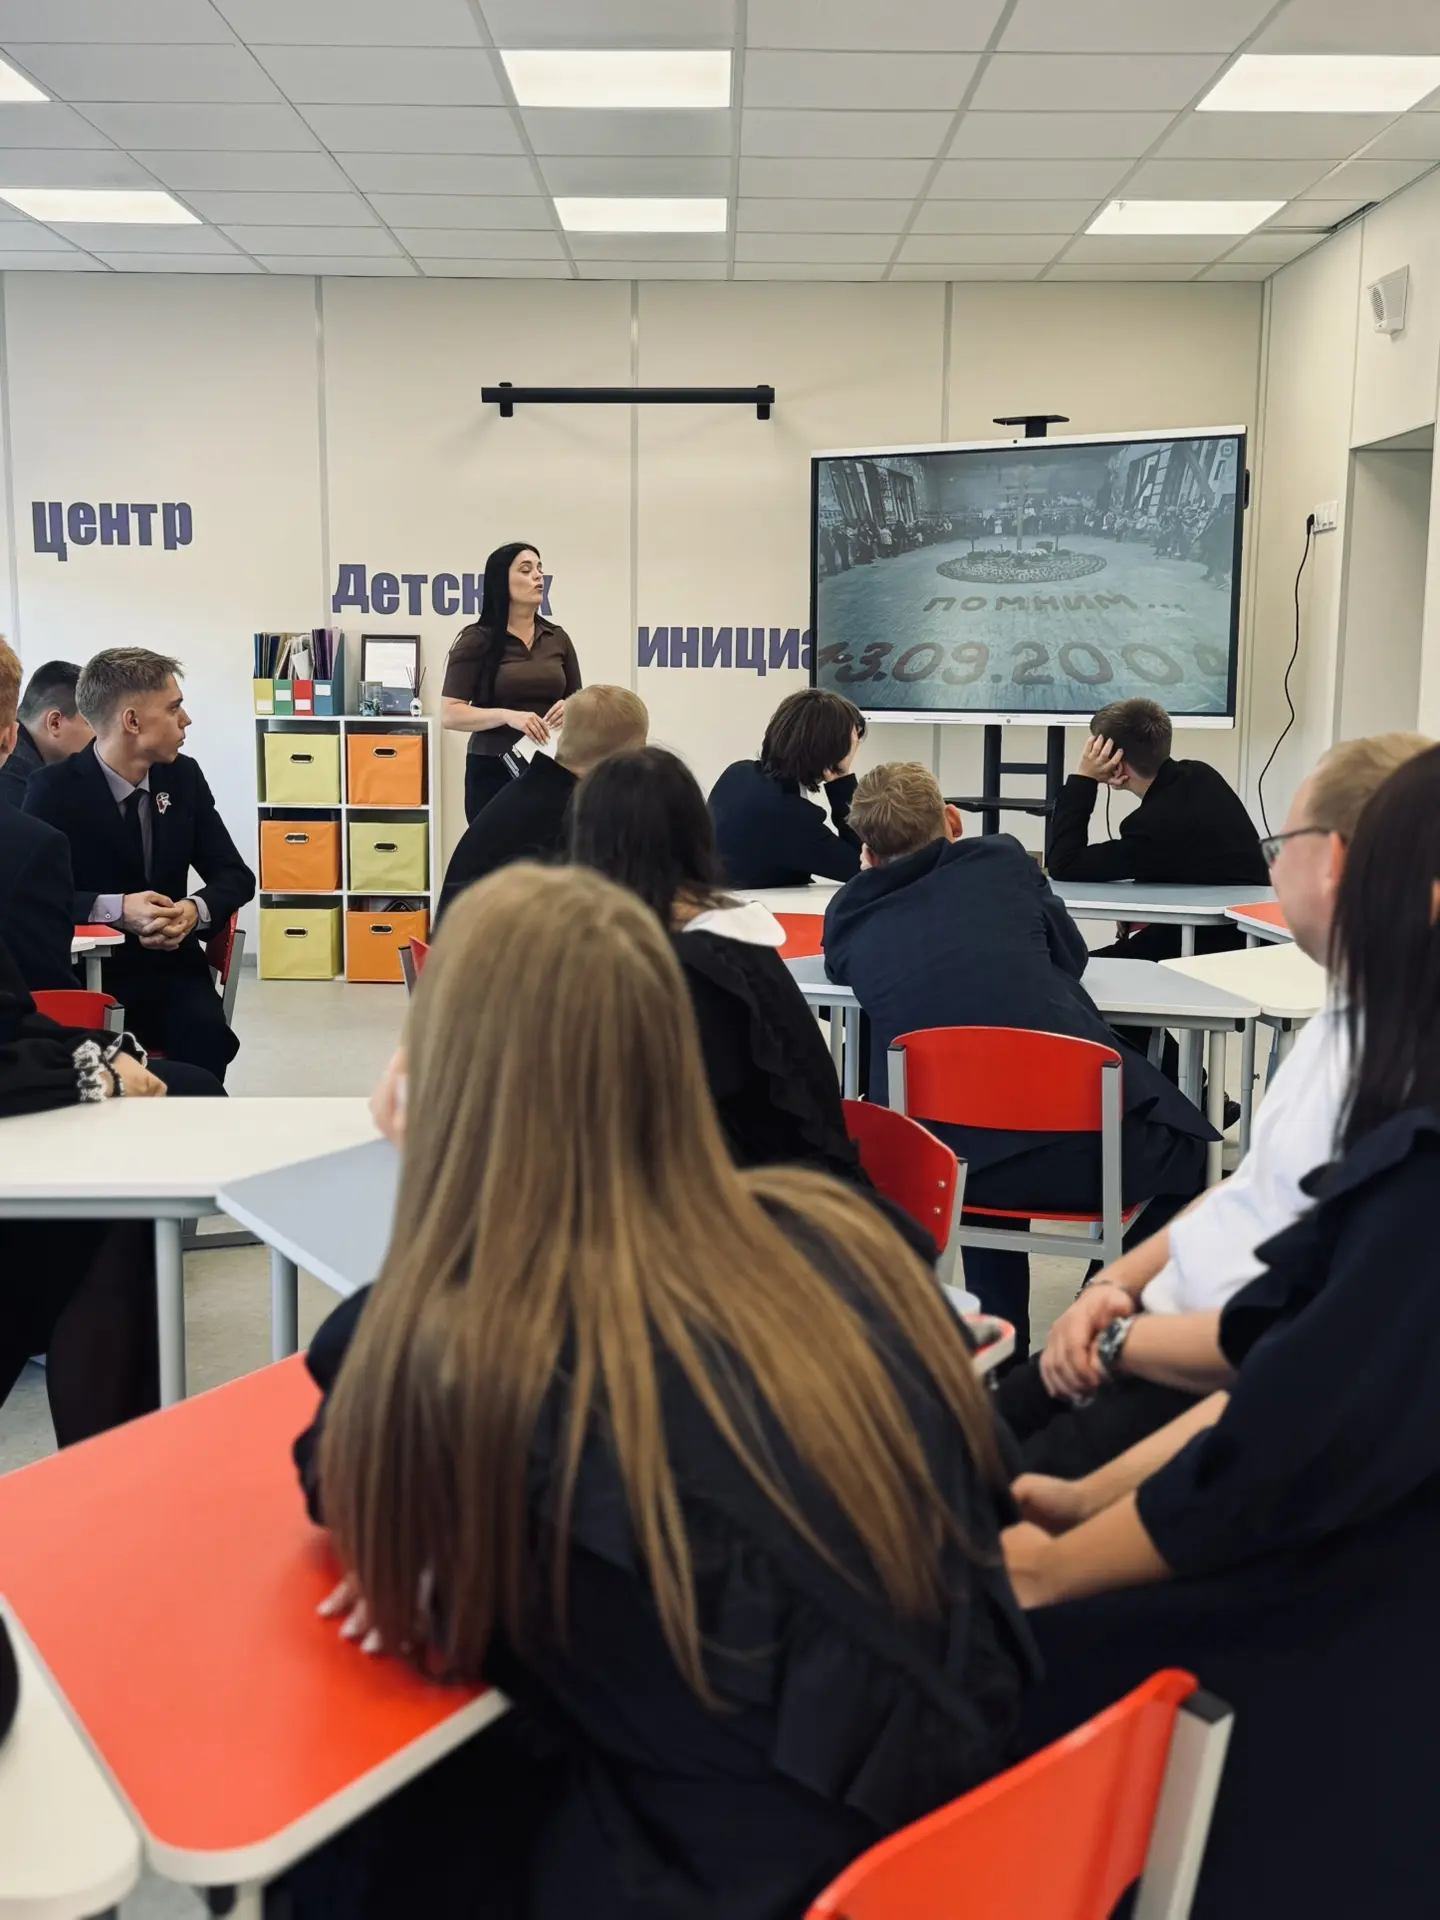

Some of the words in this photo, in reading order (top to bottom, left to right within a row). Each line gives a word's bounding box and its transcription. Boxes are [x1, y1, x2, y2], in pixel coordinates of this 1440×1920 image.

[32, 501, 193, 562] центр
[332, 563, 554, 616] Детск
[637, 626, 810, 677] иници
